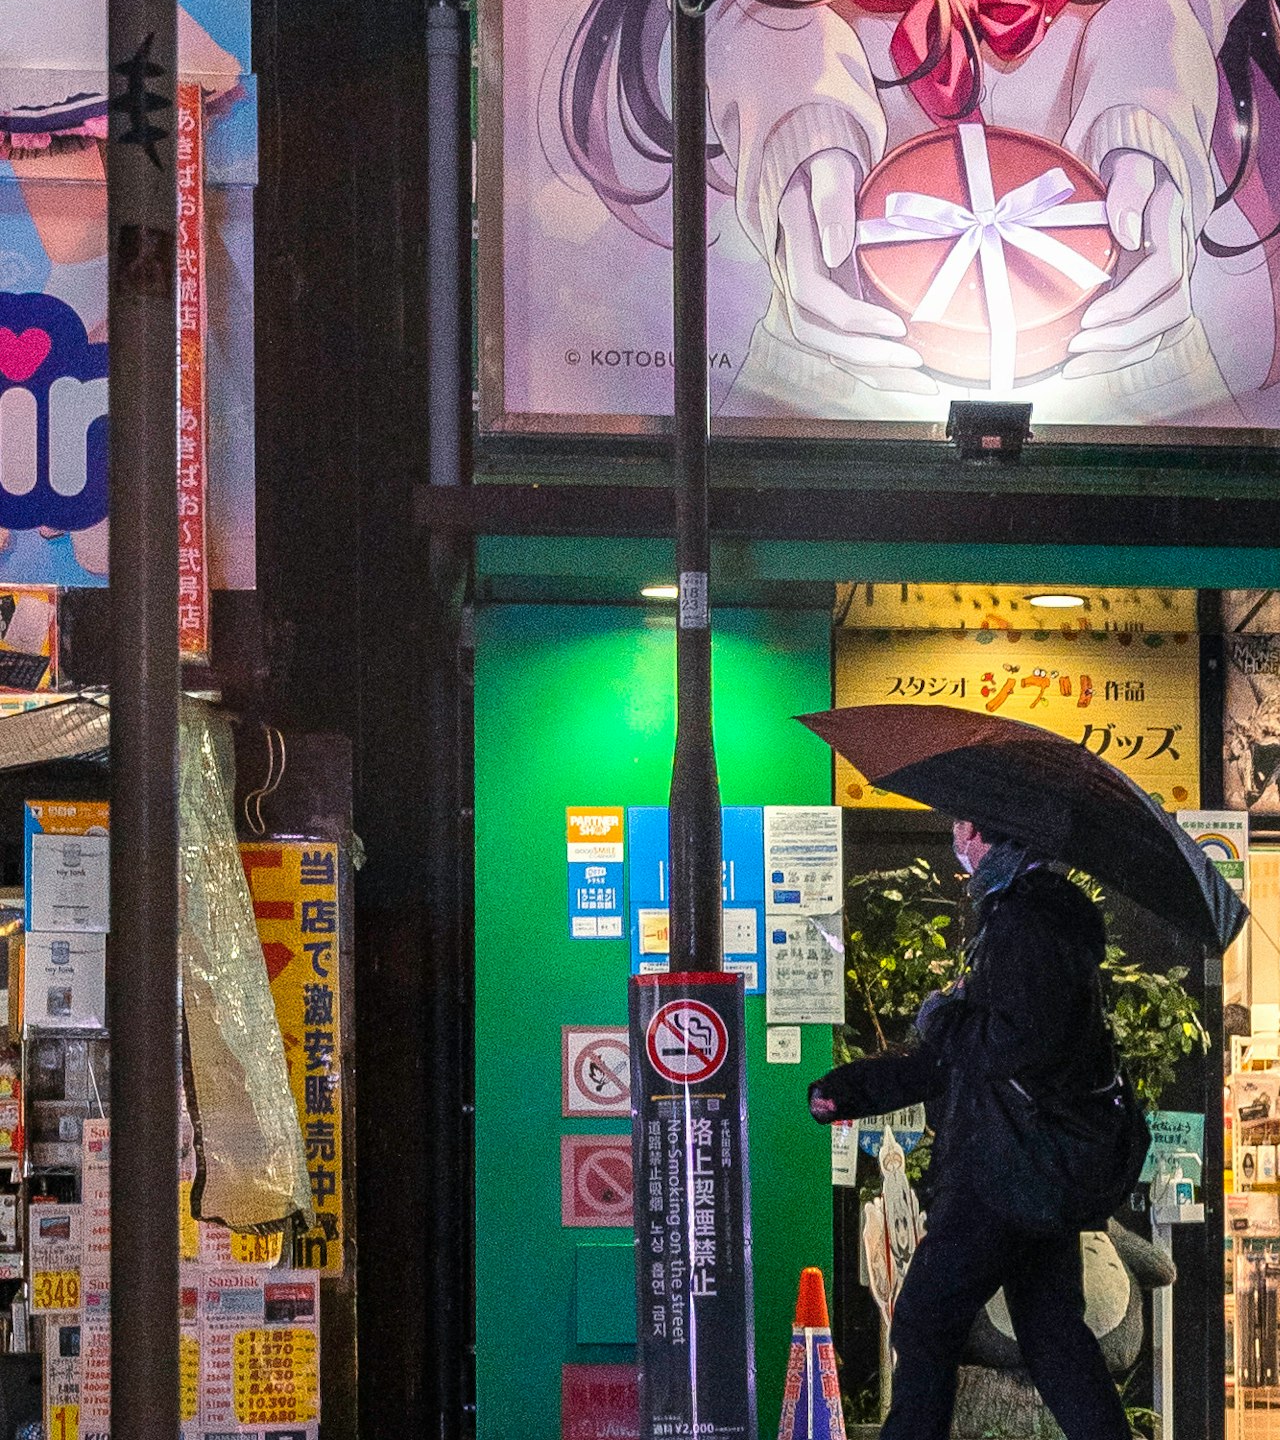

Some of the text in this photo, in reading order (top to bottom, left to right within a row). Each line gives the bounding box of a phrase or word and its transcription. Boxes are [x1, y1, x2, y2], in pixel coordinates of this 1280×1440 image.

[590, 349, 732, 369] KOTOBYA
[885, 665, 1146, 712] スタジオ ジブリ 作品
[1079, 723, 1183, 761] グッズ
[569, 815, 620, 827] PARTNER
[300, 850, 337, 1208] 当店で激安販売中
[689, 1117, 718, 1297] 路上喫煙禁止
[668, 1231, 682, 1255] on
[208, 1276, 259, 1288] SanDisk
[670, 1260, 688, 1290] the
[671, 1292, 687, 1345] street
